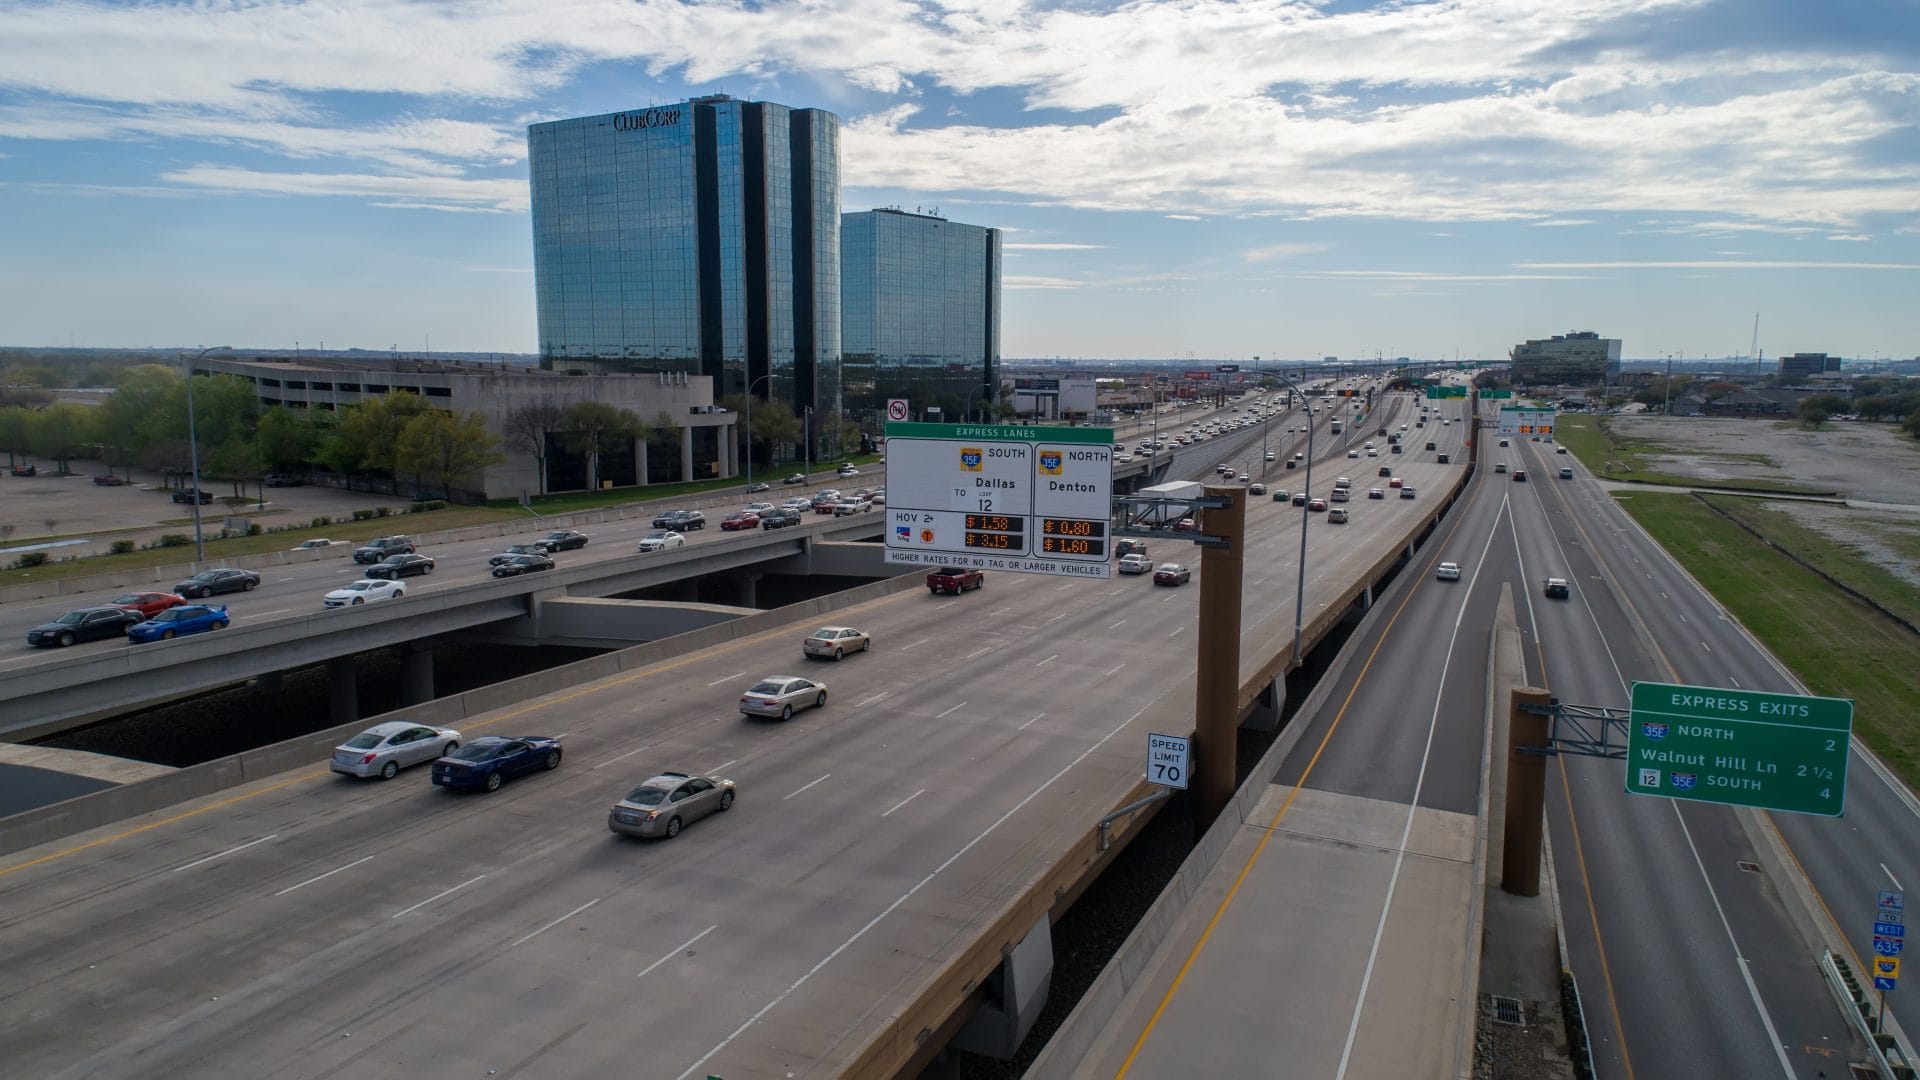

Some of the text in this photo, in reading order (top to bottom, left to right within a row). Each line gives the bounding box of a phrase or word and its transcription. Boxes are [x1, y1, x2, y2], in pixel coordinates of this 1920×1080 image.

[956, 427, 1035, 438] EXPRESS LANES
[964, 448, 1025, 465] 35E SOUTH
[1043, 451, 1108, 467] 35E NORTH
[976, 477, 1015, 489] Dallas
[1049, 481, 1096, 492] Denton
[954, 489, 966, 497] TO
[979, 499, 992, 512] 12
[896, 513, 934, 523] HOV 2+
[981, 516, 1008, 530] 1.58
[1060, 521, 1090, 535] 0.80
[981, 534, 1008, 548] 3.15
[892, 552, 1101, 575] HIGHER RATES FOR NO TAG OR LARGER VEHICLES
[1671, 694, 1809, 717] EXPRESS EXITS
[1644, 725, 1836, 751] 35E NORTH 2
[1151, 739, 1185, 752] SPEED
[1154, 752, 1181, 763] LIMIT
[1641, 748, 1705, 766] Walnut
[1715, 756, 1746, 771] Hill
[1756, 761, 1777, 774] Ln
[1797, 765, 1807, 777] 2
[1154, 763, 1180, 782] 70
[1643, 775, 1830, 799] 12 35E SOUTH 4
[1877, 924, 1901, 936] WEST
[1876, 941, 1900, 954] 635
